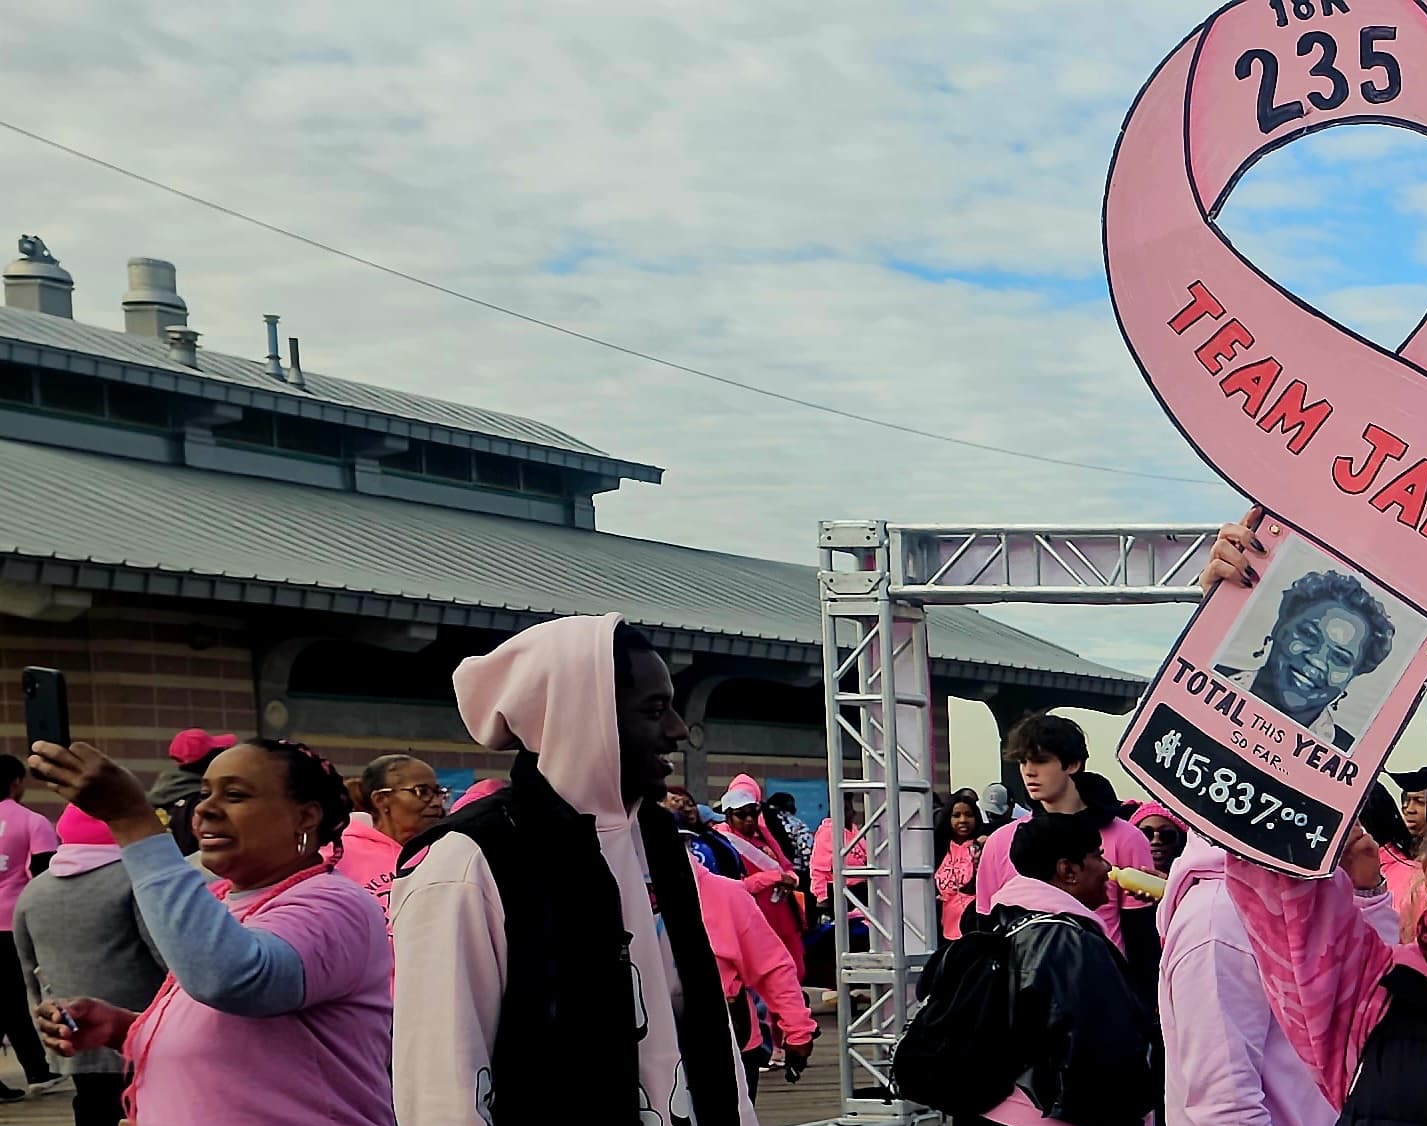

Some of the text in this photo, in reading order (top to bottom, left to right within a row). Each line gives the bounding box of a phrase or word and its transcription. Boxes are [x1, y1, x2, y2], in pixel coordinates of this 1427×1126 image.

[1235, 26, 1402, 134] 235
[1167, 279, 1334, 455] TEAM
[1172, 656, 1359, 786] TOTAL THIS YEAR
[1230, 730, 1248, 749] SO
